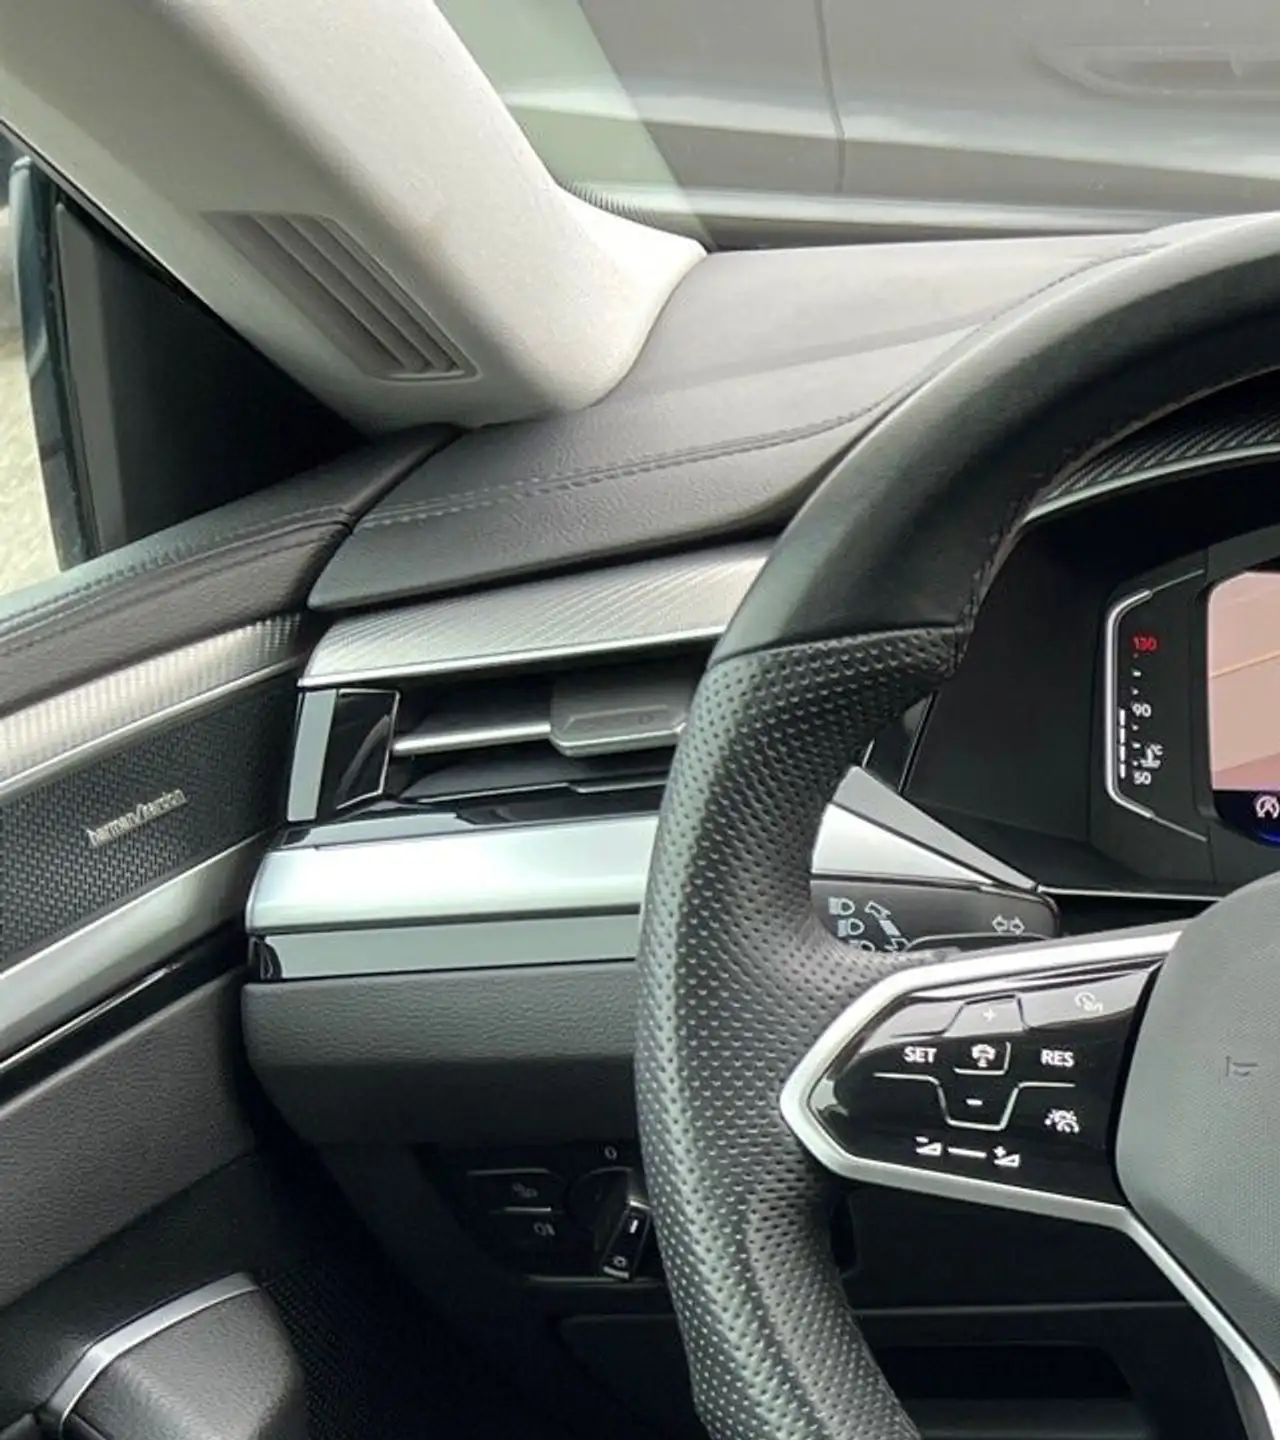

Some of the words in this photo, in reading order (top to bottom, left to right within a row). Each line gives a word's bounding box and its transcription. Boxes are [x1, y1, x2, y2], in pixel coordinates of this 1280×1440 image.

[1131, 703, 1152, 718] 90
[1133, 771, 1152, 785] 50
[904, 1045, 937, 1064] SET
[1041, 1050, 1075, 1068] RES
